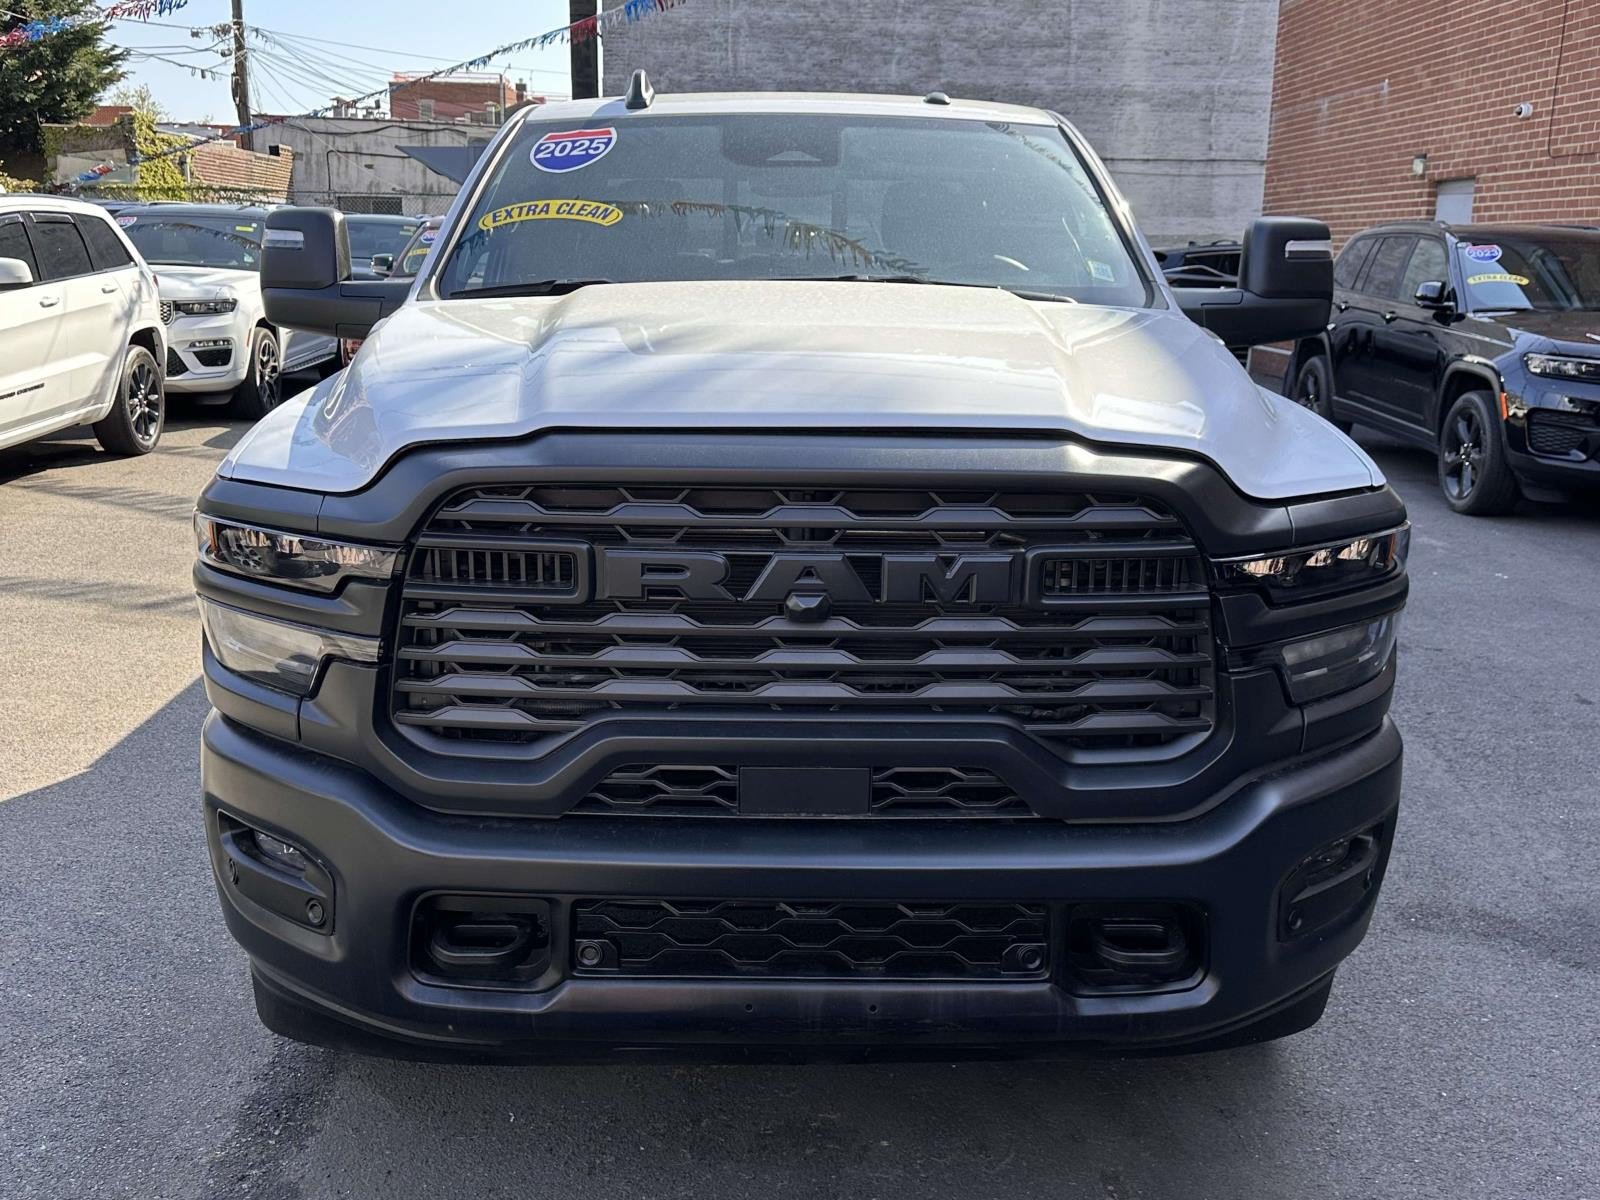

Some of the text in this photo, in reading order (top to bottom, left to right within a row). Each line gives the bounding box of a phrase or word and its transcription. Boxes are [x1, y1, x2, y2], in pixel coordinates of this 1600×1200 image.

[536, 138, 608, 158] 2025
[492, 202, 614, 223] EXTRA CLEAN
[604, 548, 1015, 602] RAM
